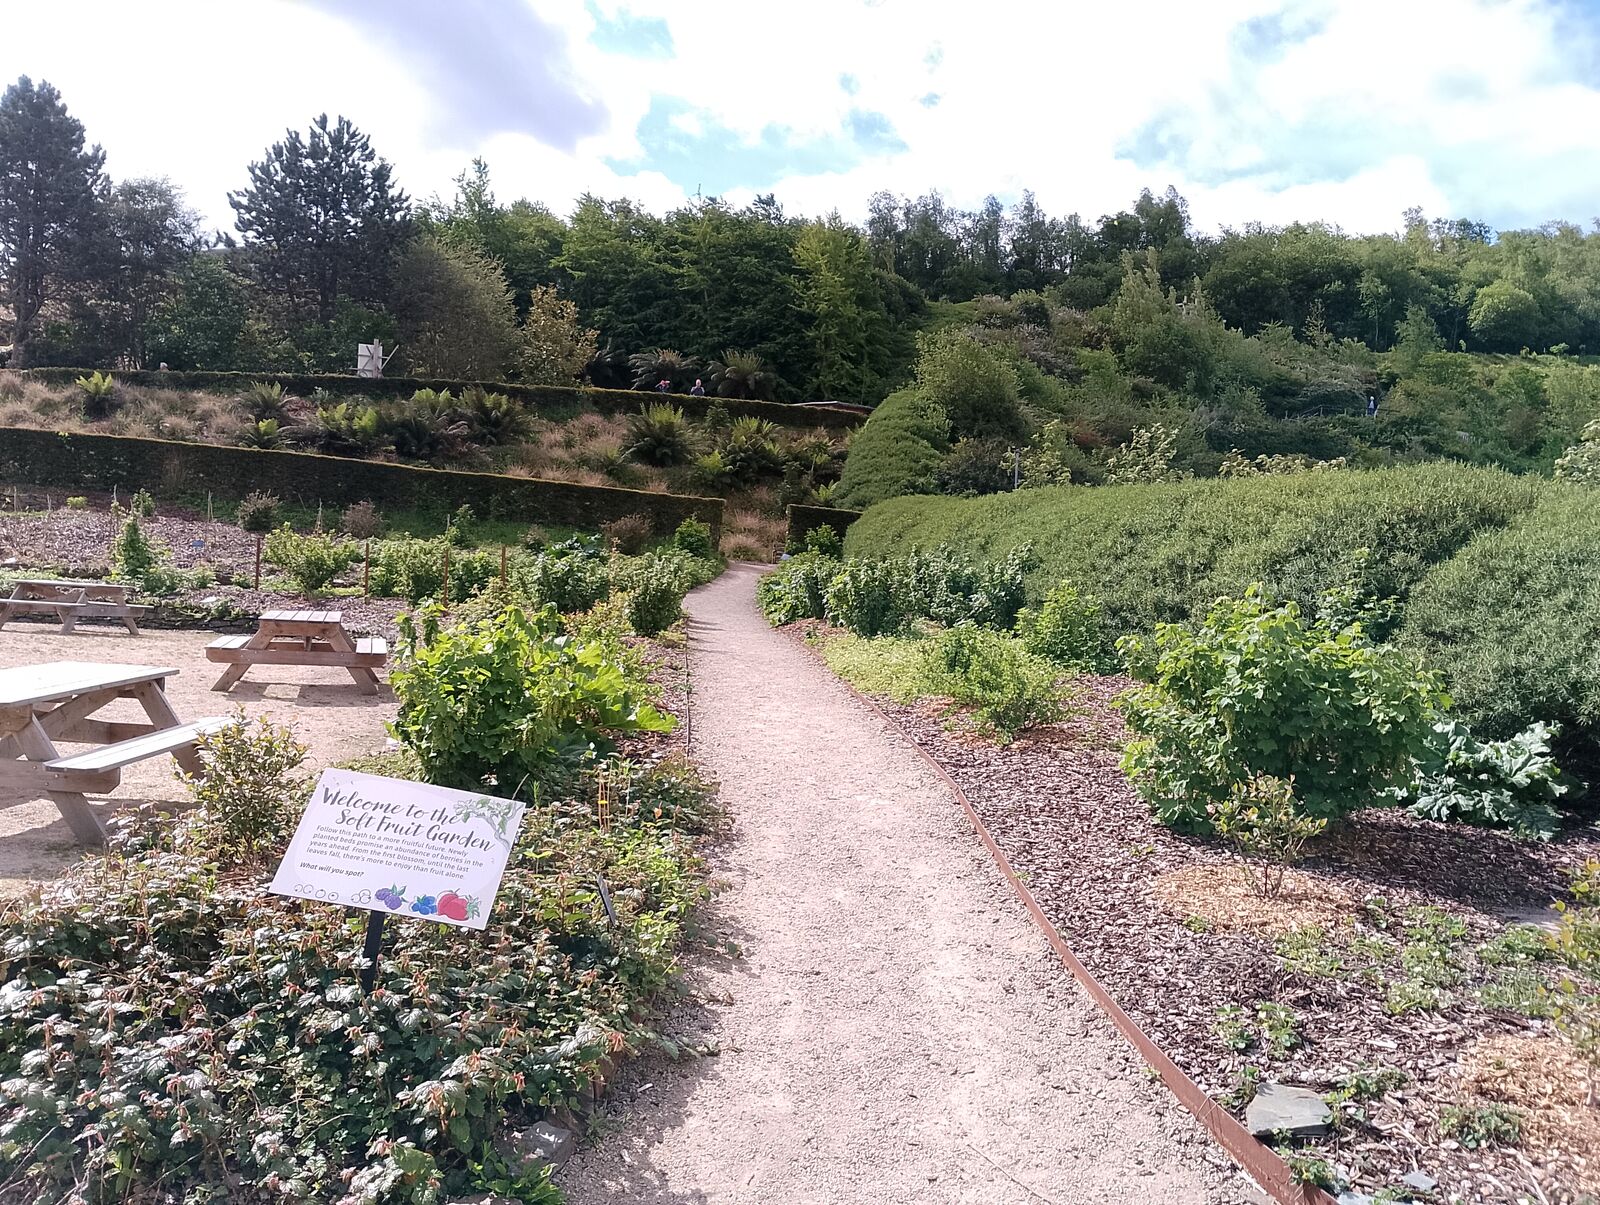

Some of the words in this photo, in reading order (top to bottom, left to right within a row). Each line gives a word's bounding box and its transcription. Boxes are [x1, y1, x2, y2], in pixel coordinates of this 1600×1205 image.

[323, 787, 404, 814] Welcome
[406, 804, 429, 819] to
[430, 807, 459, 825] the
[317, 825, 338, 834] Follow
[401, 839, 424, 848] fruitful
[425, 843, 446, 852] future.
[448, 848, 468, 857] Newly
[335, 809, 376, 831] Soft
[376, 816, 424, 837] Fruit
[426, 825, 495, 851] Garden
[306, 847, 328, 855] leaves
[329, 850, 341, 858] fall,
[366, 857, 384, 865] more
[393, 862, 412, 870] enjoy
[413, 865, 428, 873] than
[429, 868, 444, 876] fruit
[313, 833, 339, 842] planted
[340, 836, 355, 844] beds
[357, 840, 383, 849] promise
[395, 846, 430, 857] abundance
[440, 854, 463, 863] berries
[370, 849, 381, 857] the
[382, 851, 396, 859] first
[397, 854, 426, 865] blossom,
[444, 862, 455, 870] the
[456, 864, 469, 872] last
[300, 862, 318, 870] What
[344, 869, 364, 877] spot?
